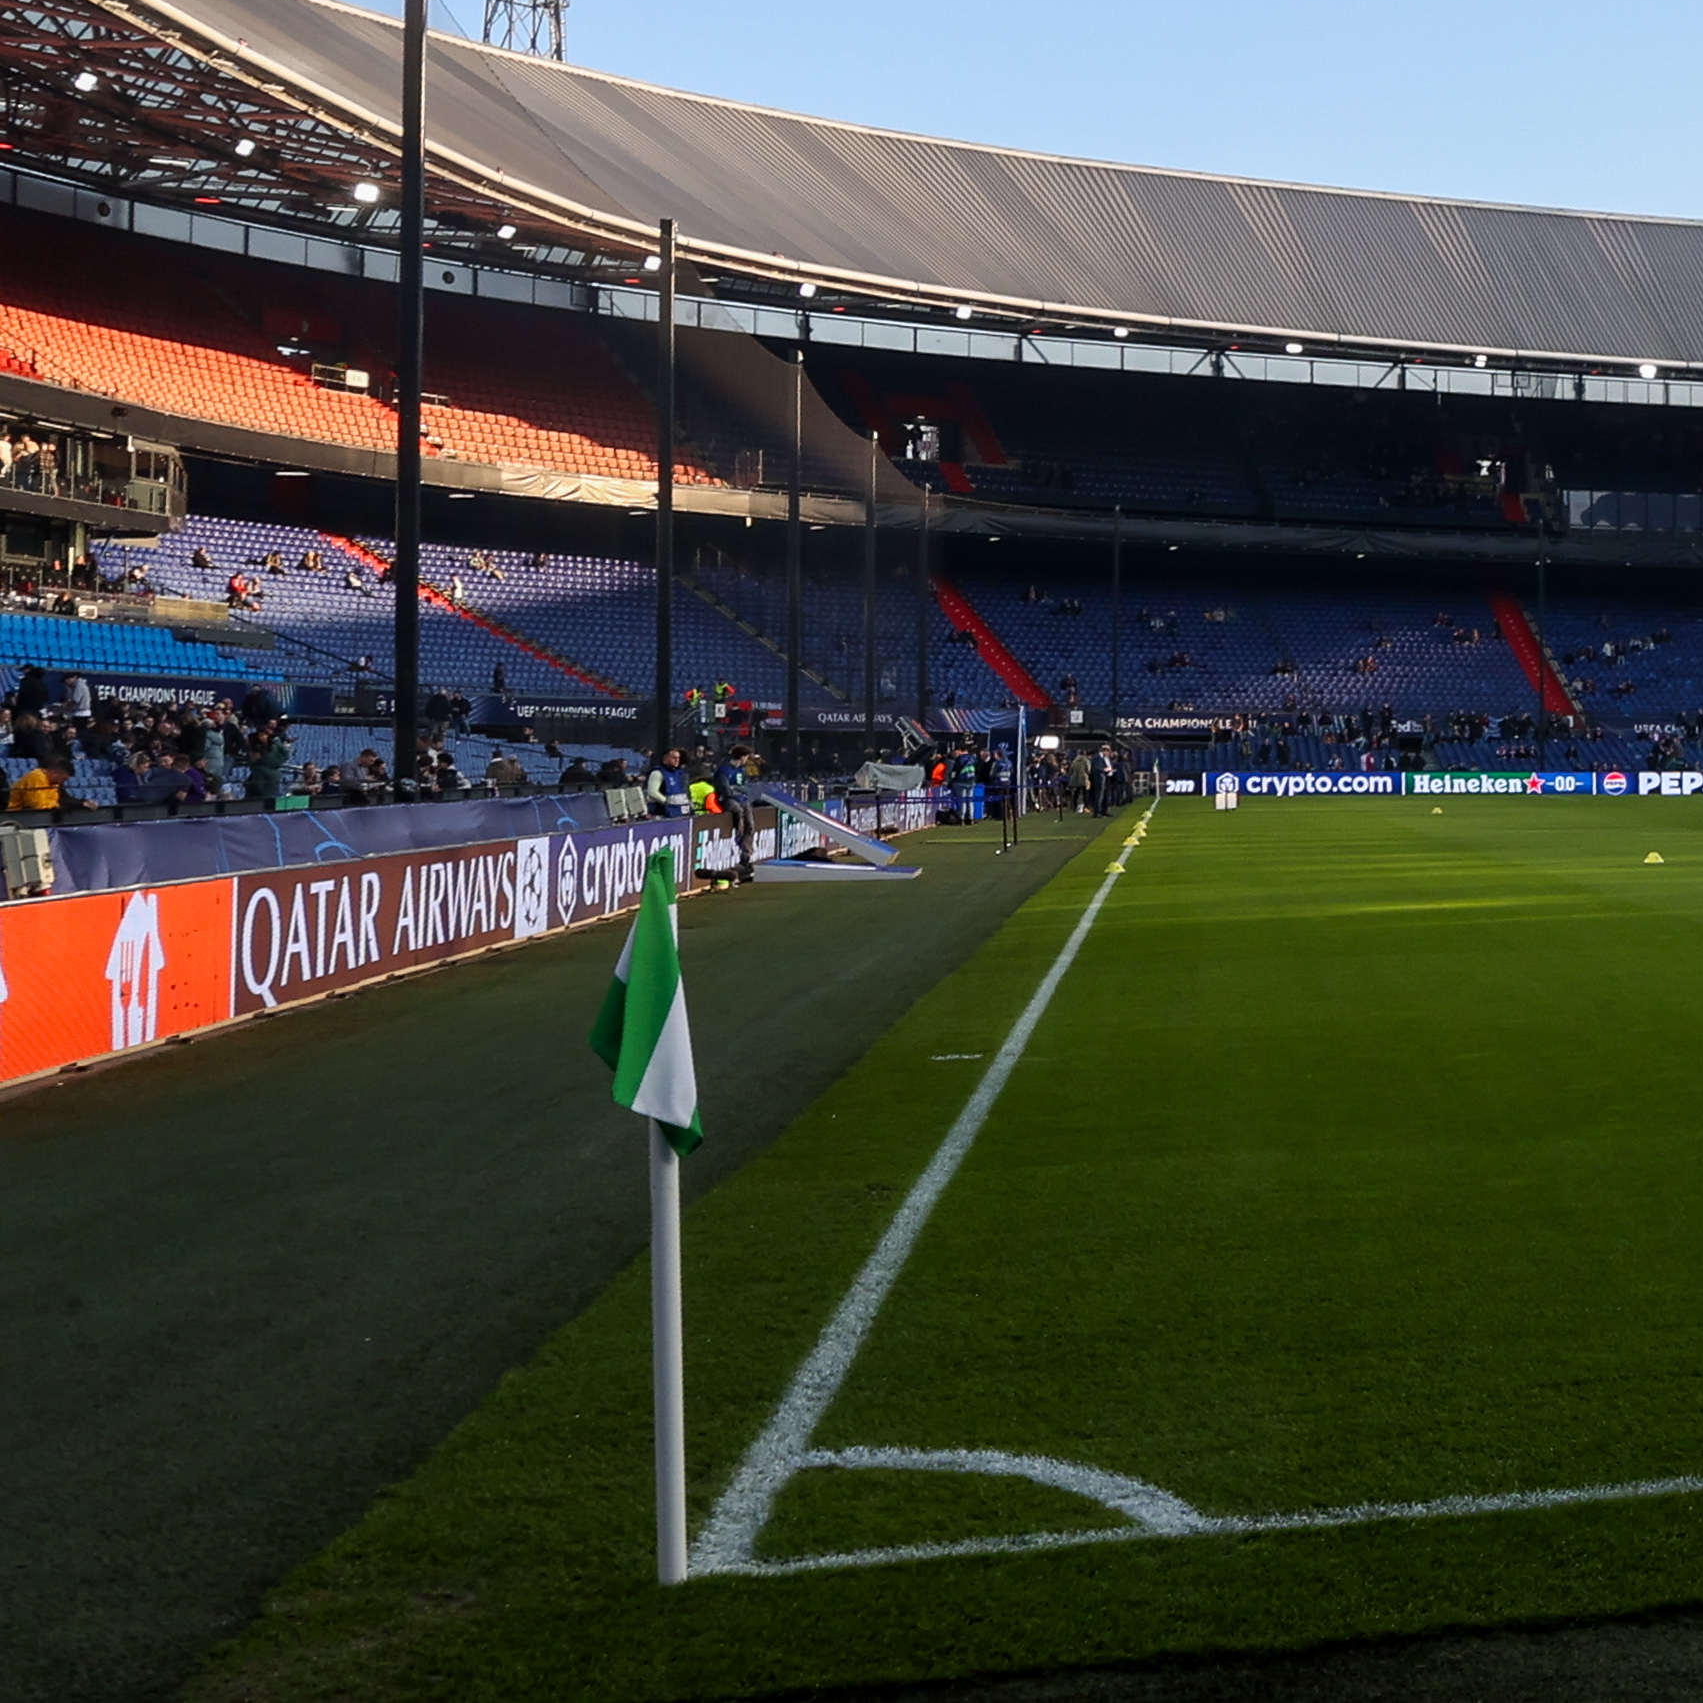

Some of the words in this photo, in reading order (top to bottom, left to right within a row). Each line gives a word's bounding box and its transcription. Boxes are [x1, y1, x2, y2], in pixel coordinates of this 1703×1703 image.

[95, 684, 116, 700] EFA
[119, 686, 176, 703] CHAMPIONS
[179, 689, 216, 705] LEAGUE
[817, 712, 850, 724] QATAR
[1246, 772, 1393, 797] crypto.com
[1413, 774, 1523, 794] Heineken
[242, 872, 381, 1008] QATAR
[392, 851, 515, 955] AIRWAYS
